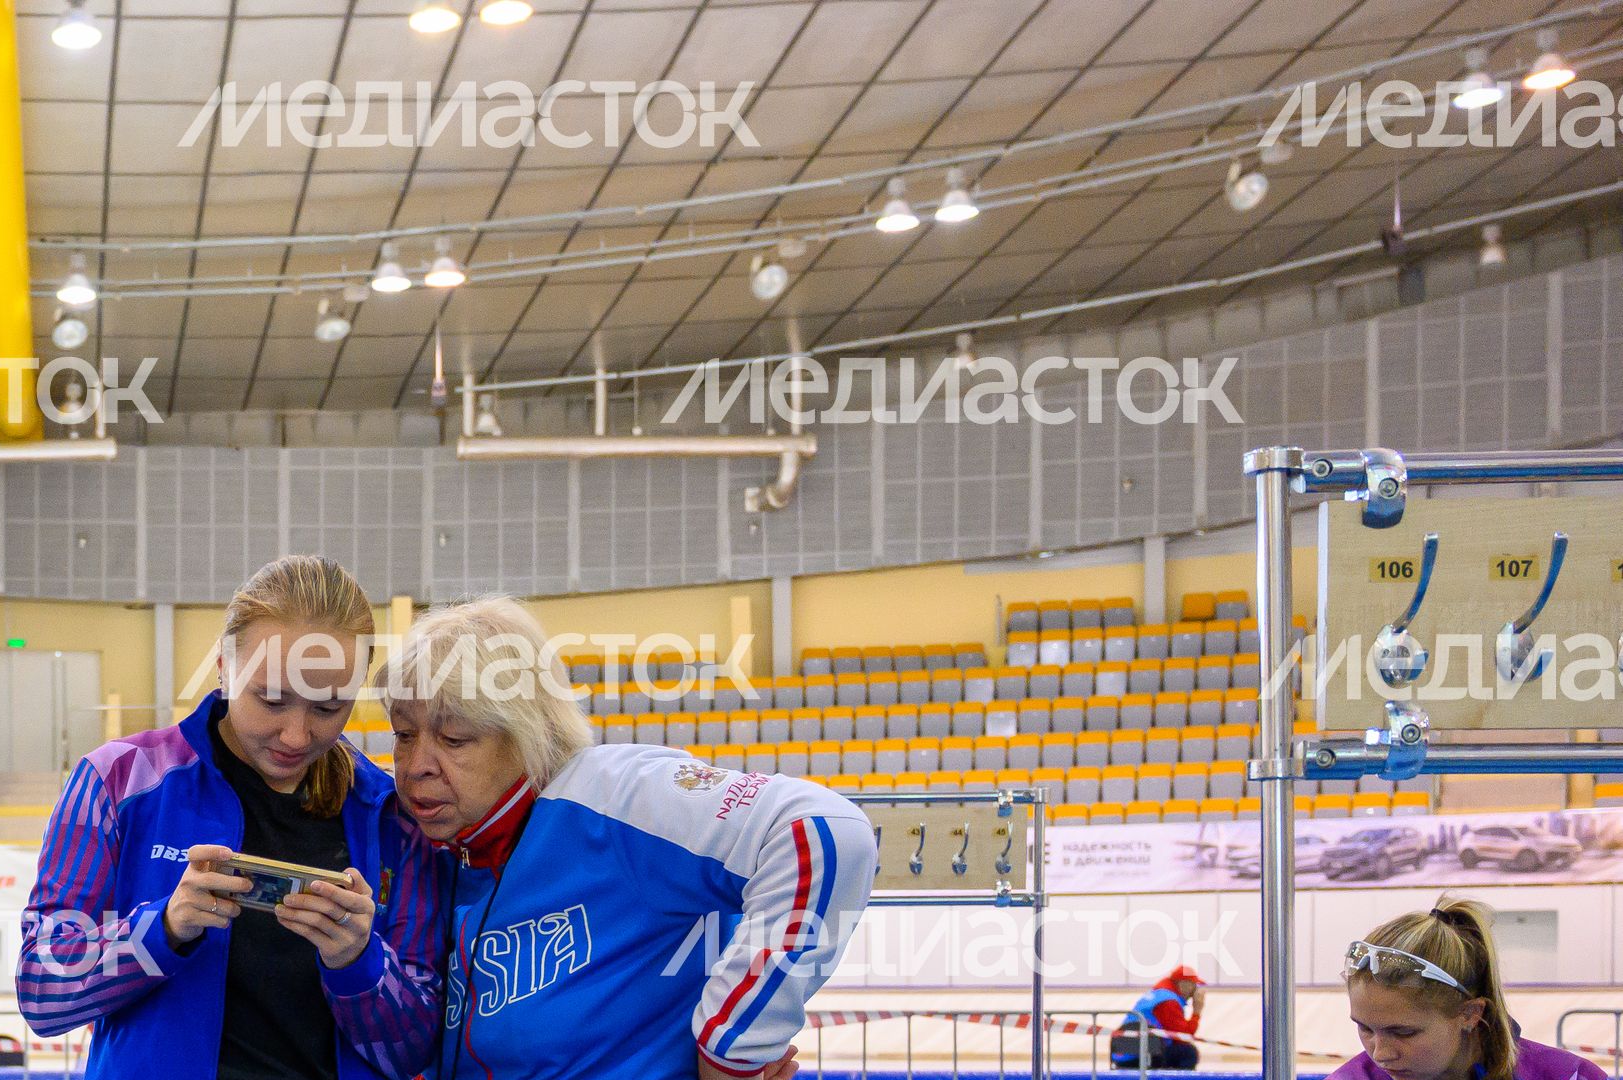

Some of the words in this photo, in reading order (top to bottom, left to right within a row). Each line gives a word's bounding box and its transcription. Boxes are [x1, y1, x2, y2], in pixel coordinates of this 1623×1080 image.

[1376, 561, 1414, 579] 106
[1496, 560, 1534, 578] 107
[735, 775, 771, 809] TEAM
[446, 904, 592, 1030] SSIA
